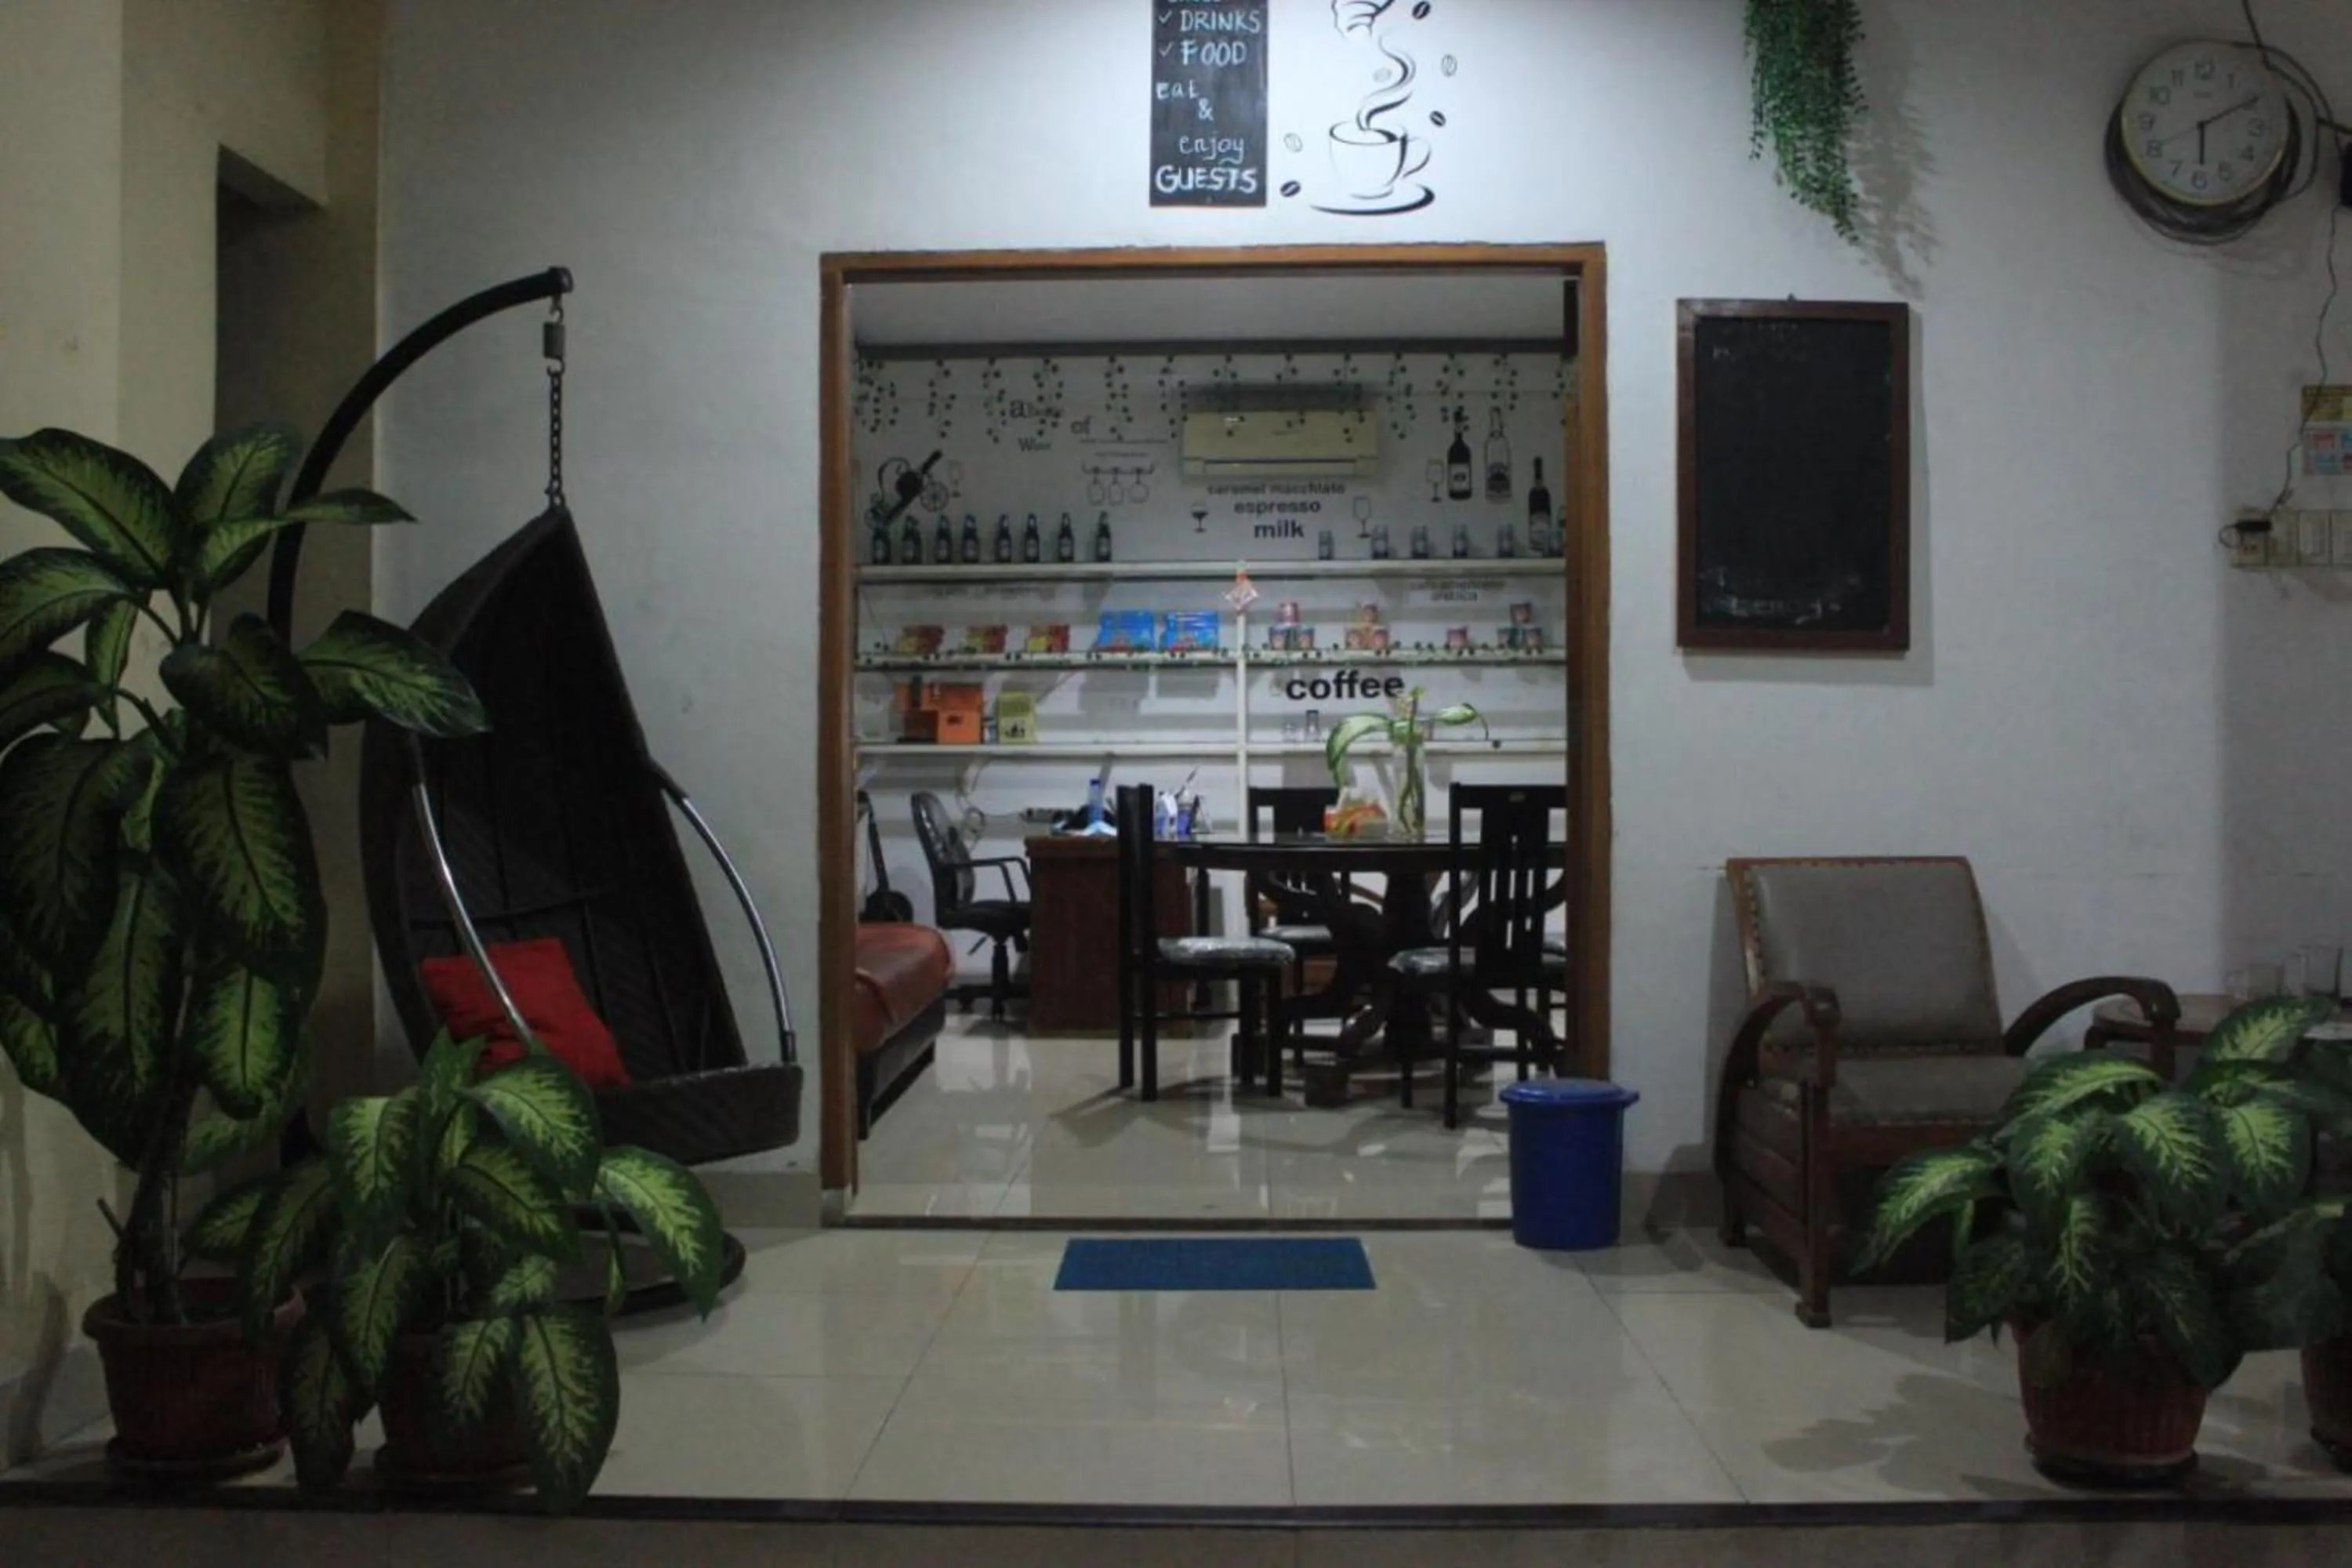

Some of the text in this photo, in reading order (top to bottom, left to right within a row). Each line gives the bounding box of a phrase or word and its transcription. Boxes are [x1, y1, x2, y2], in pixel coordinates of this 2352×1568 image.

[1179, 9, 1261, 34] DRINKS
[1180, 39, 1247, 67] FOOD
[1156, 79, 1199, 100] eat
[1198, 96, 1214, 121] &
[1179, 132, 1245, 163] enjoy
[1155, 165, 1258, 194] GUESTS
[2169, 159, 2183, 178] 7
[1233, 500, 1321, 517] espresso
[1254, 518, 1305, 539] milk
[1286, 670, 1406, 701] coffee
